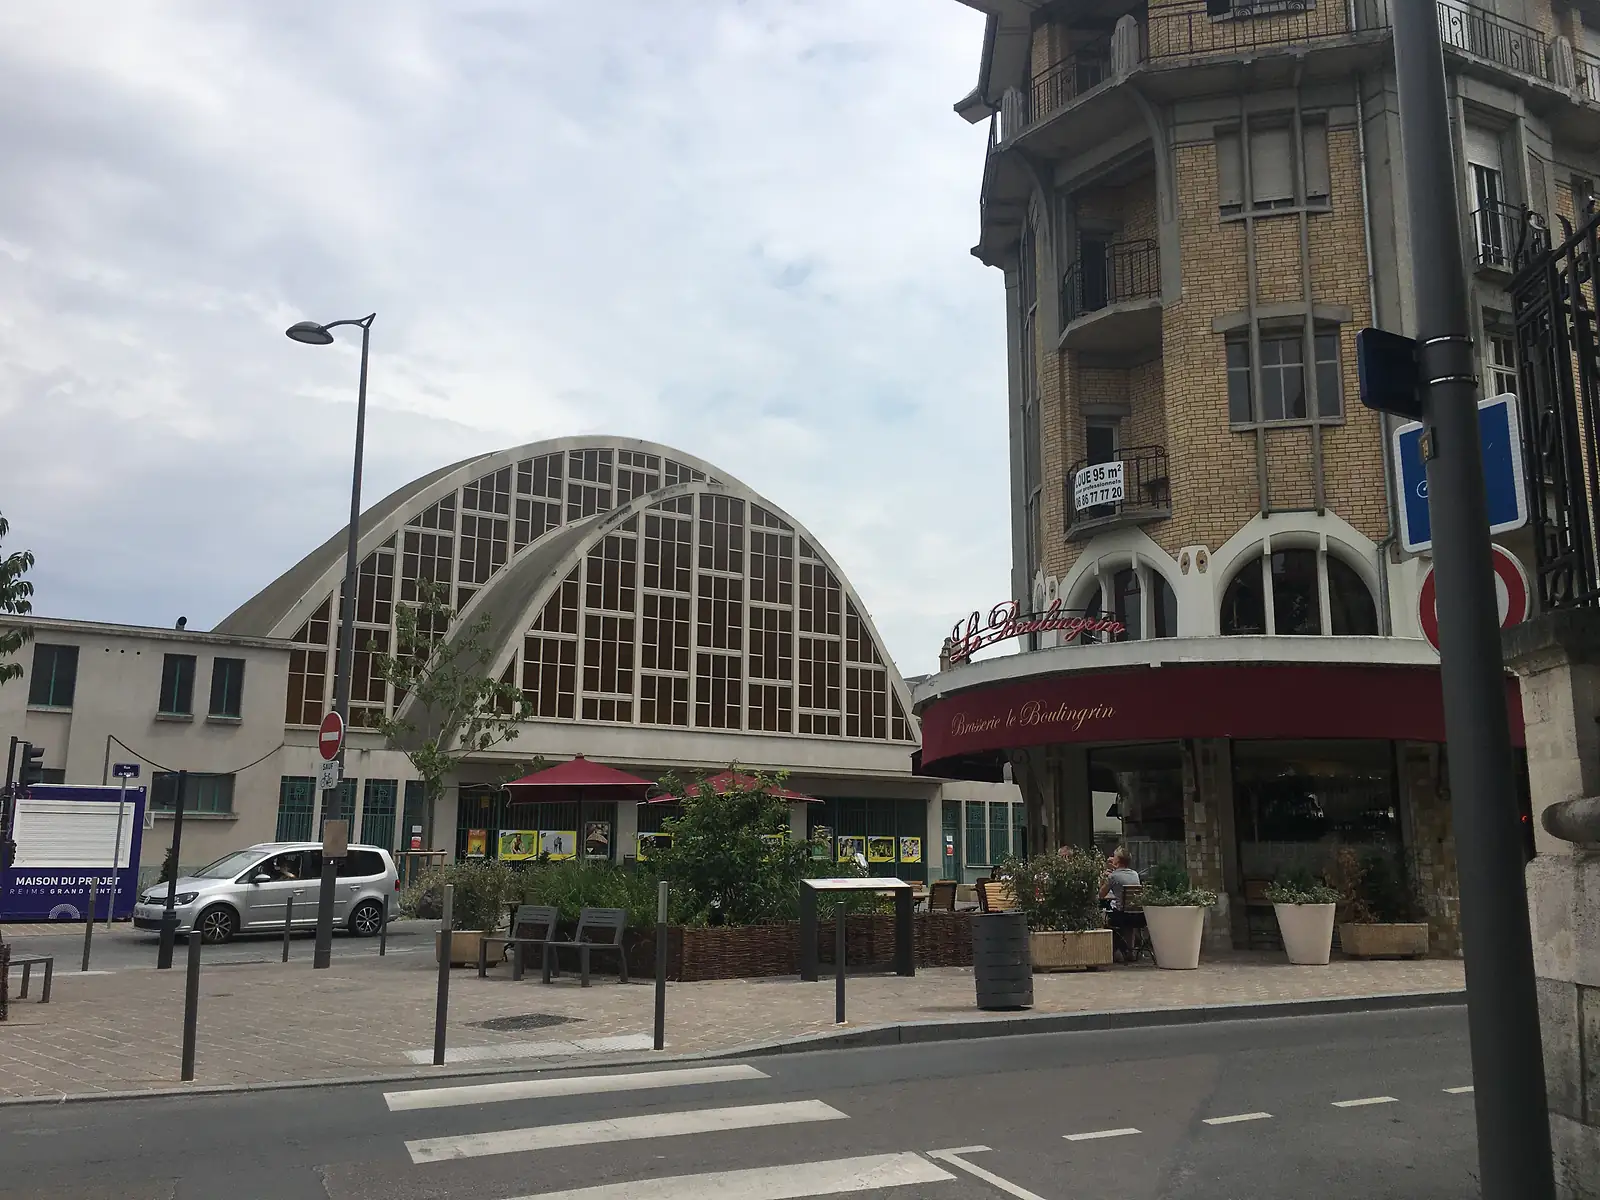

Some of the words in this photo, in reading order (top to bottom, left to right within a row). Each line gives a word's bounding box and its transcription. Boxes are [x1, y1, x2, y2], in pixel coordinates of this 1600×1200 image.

[1093, 467, 1105, 481] 95
[1090, 490, 1098, 503] 77
[1100, 488, 1109, 501] 77
[1111, 486, 1122, 499] 20
[987, 598, 1126, 642] Boulingrin
[951, 712, 1001, 737] Brasserie
[1005, 708, 1017, 728] le
[1020, 699, 1117, 732] Boulingrin
[15, 876, 59, 886] MAISON
[61, 876, 76, 886] DU
